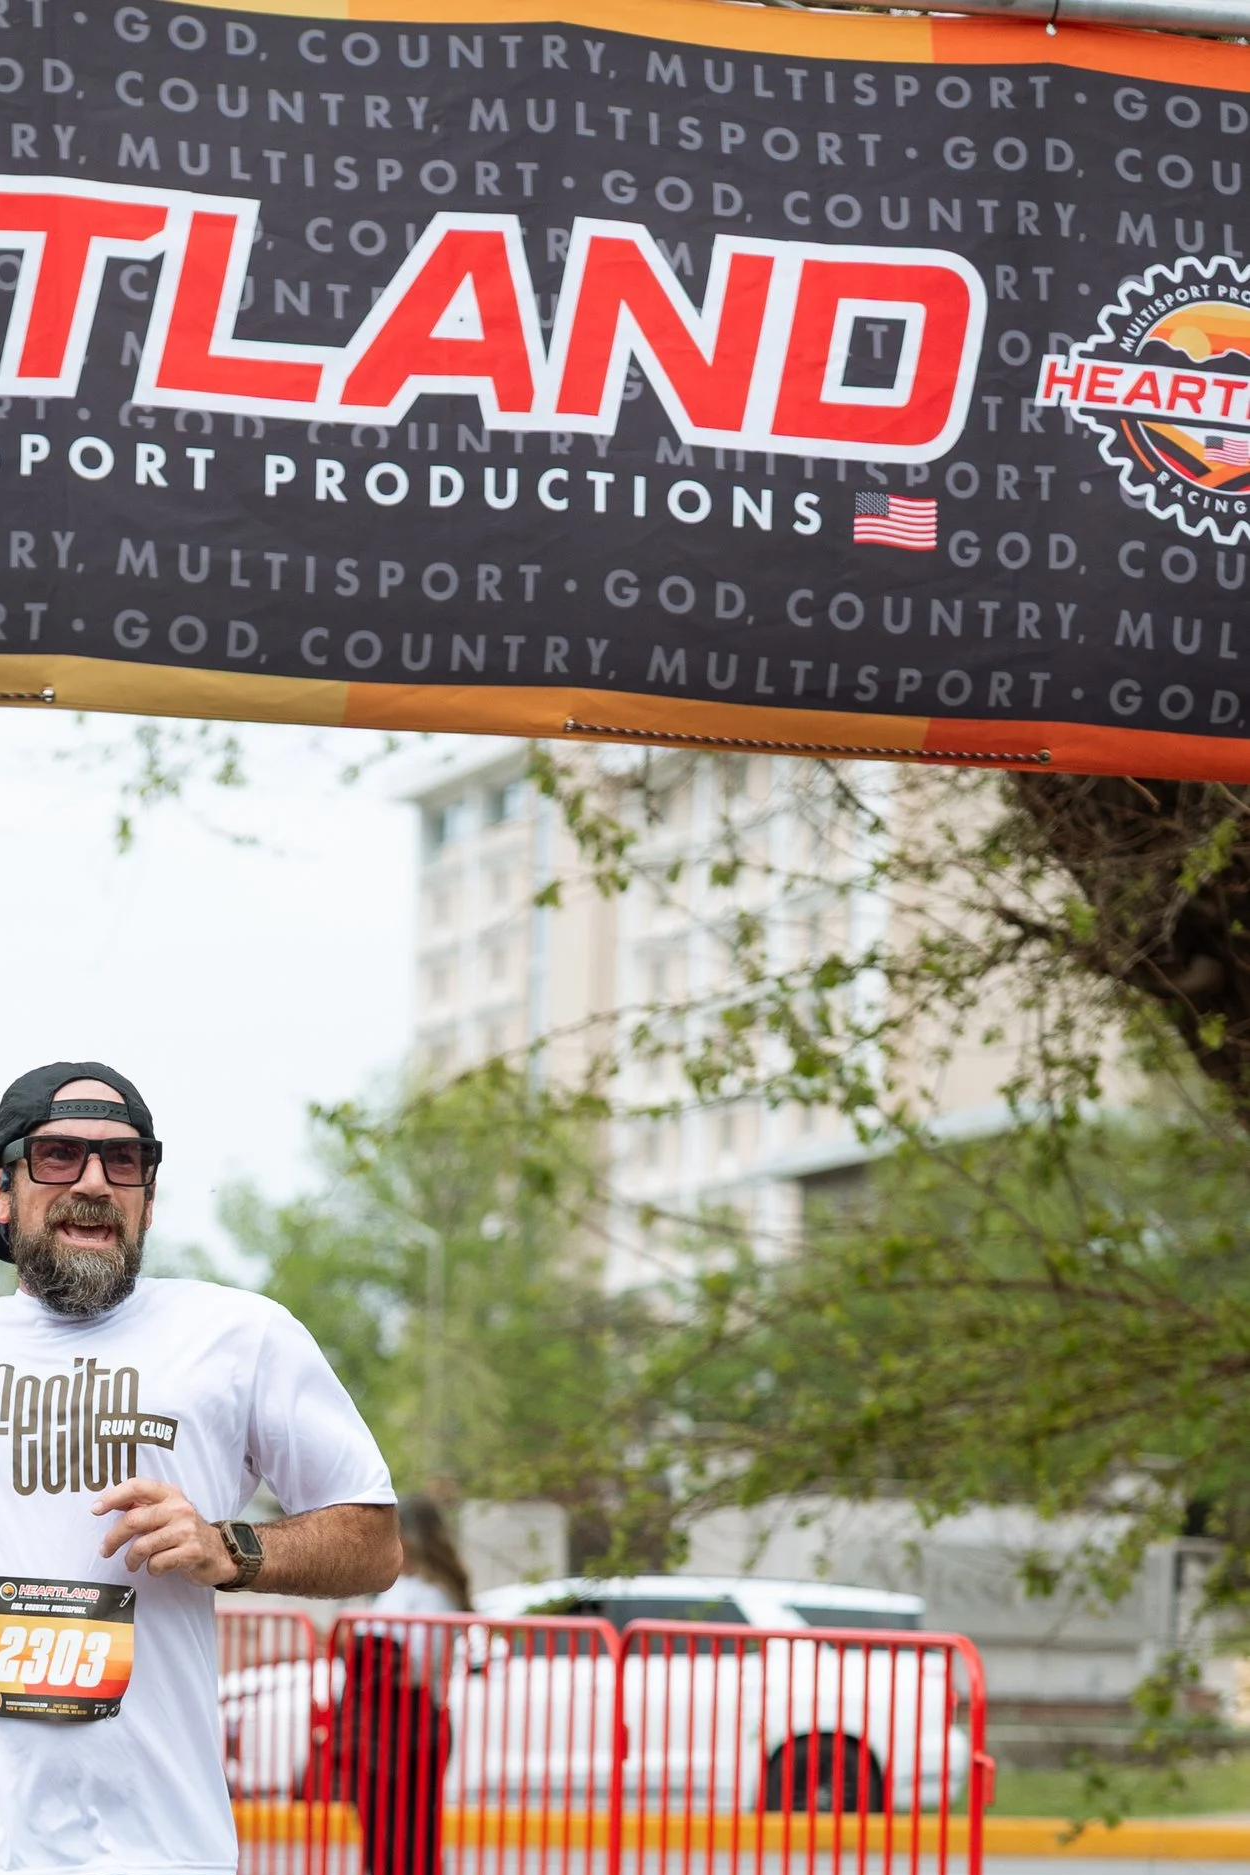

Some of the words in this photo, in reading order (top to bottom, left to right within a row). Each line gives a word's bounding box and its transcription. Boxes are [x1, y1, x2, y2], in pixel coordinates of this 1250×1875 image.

[114, 7, 267, 61] GOD,
[298, 29, 617, 79] COUNTRY,
[646, 50, 1051, 109] MULTISPORT
[115, 71, 440, 133] COUNTRY,
[468, 98, 882, 167] MULTISPORT
[943, 136, 1085, 178] GOD,
[118, 133, 540, 197] MULTISPORT
[602, 169, 753, 223] GOD,
[783, 190, 1086, 242] COUNTRY,
[1119, 284, 1211, 353] MULTISPORT
[1040, 361, 1250, 418] HEART
[264, 453, 824, 537] PRODUCTIONS
[1156, 470, 1247, 514] RACING
[949, 530, 1087, 575] GOD,
[116, 538, 542, 602] MULTISPORT
[604, 569, 754, 625] GOD,
[786, 589, 1086, 644] COUNTRY,
[112, 609, 267, 664] GOD,
[300, 626, 617, 680] COUNTRY,
[647, 645, 1052, 708] MULTISPORT
[99, 1419, 136, 1436] RUN
[139, 1420, 174, 1442] CLUB
[18, 1584, 100, 1601] HEARTLAND
